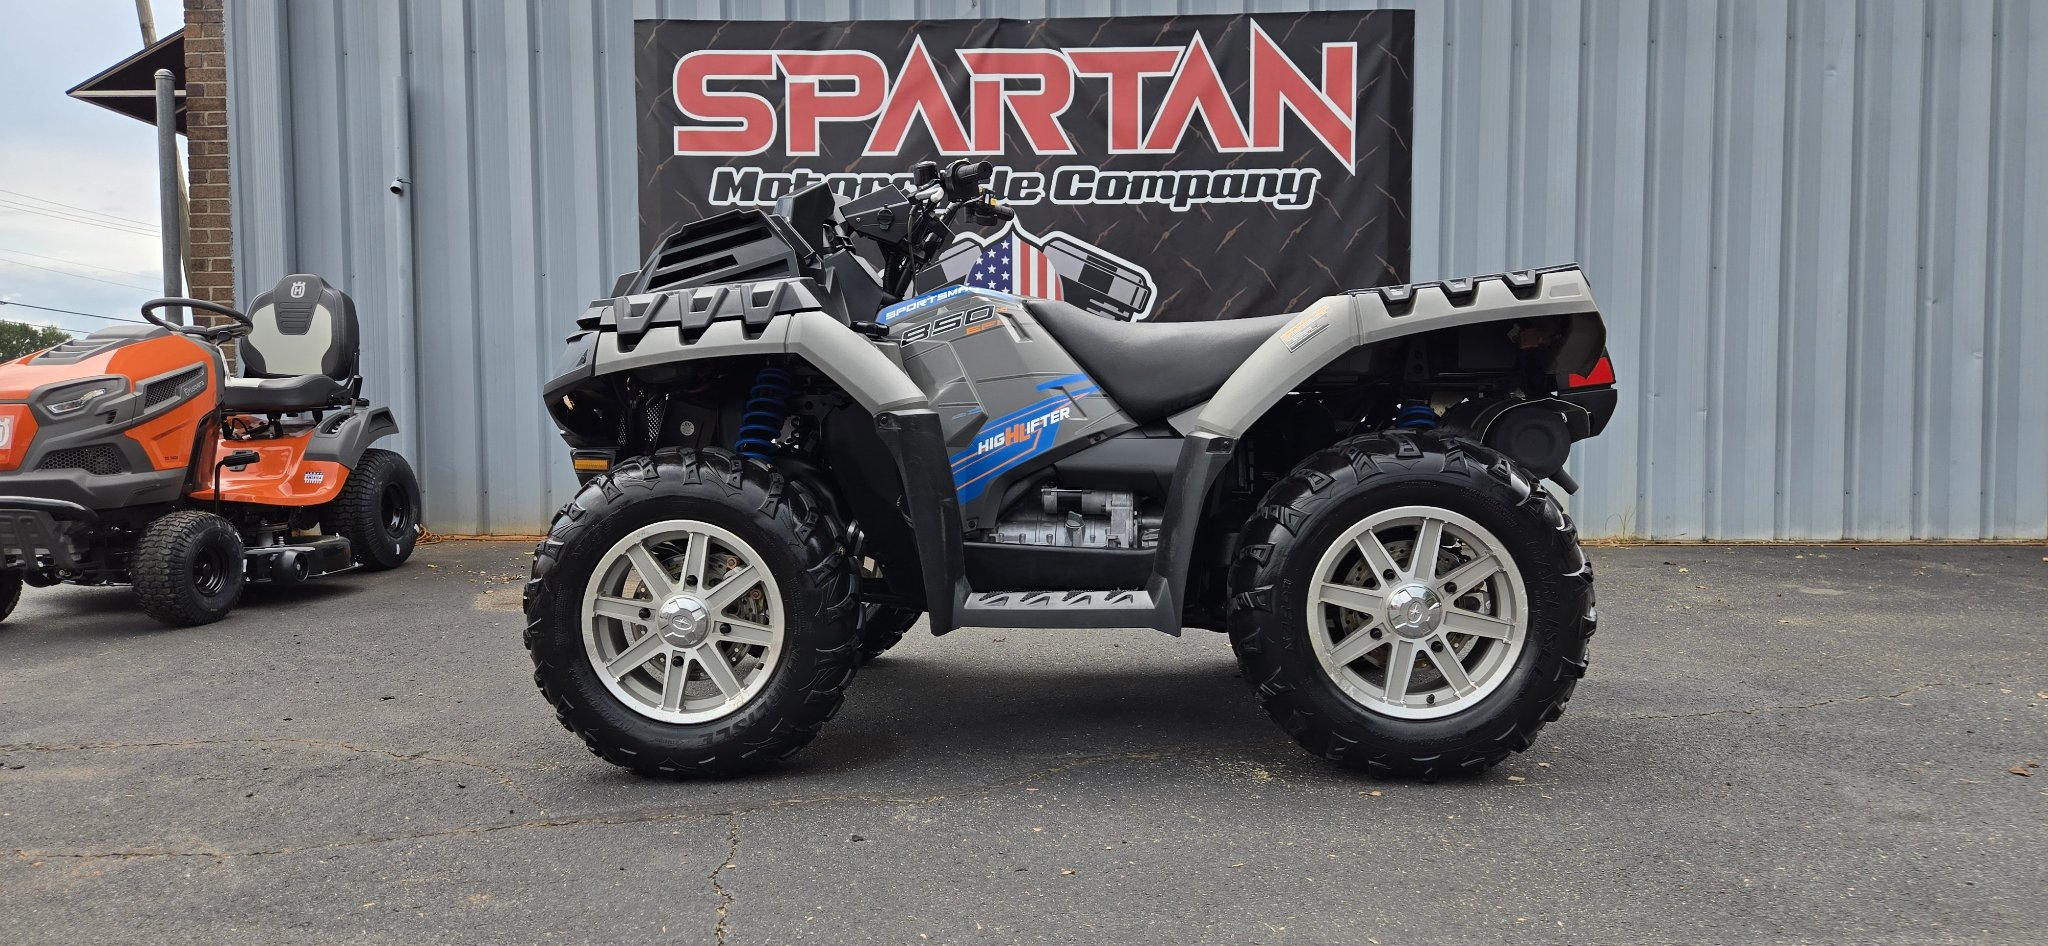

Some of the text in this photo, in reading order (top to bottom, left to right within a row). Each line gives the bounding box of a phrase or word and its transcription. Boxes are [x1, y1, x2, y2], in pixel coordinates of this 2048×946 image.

[674, 17, 1356, 175] SPARTAN
[709, 166, 1321, 211] Motorcle Company
[885, 285, 977, 320] SPORTSMA
[900, 304, 996, 349] 850
